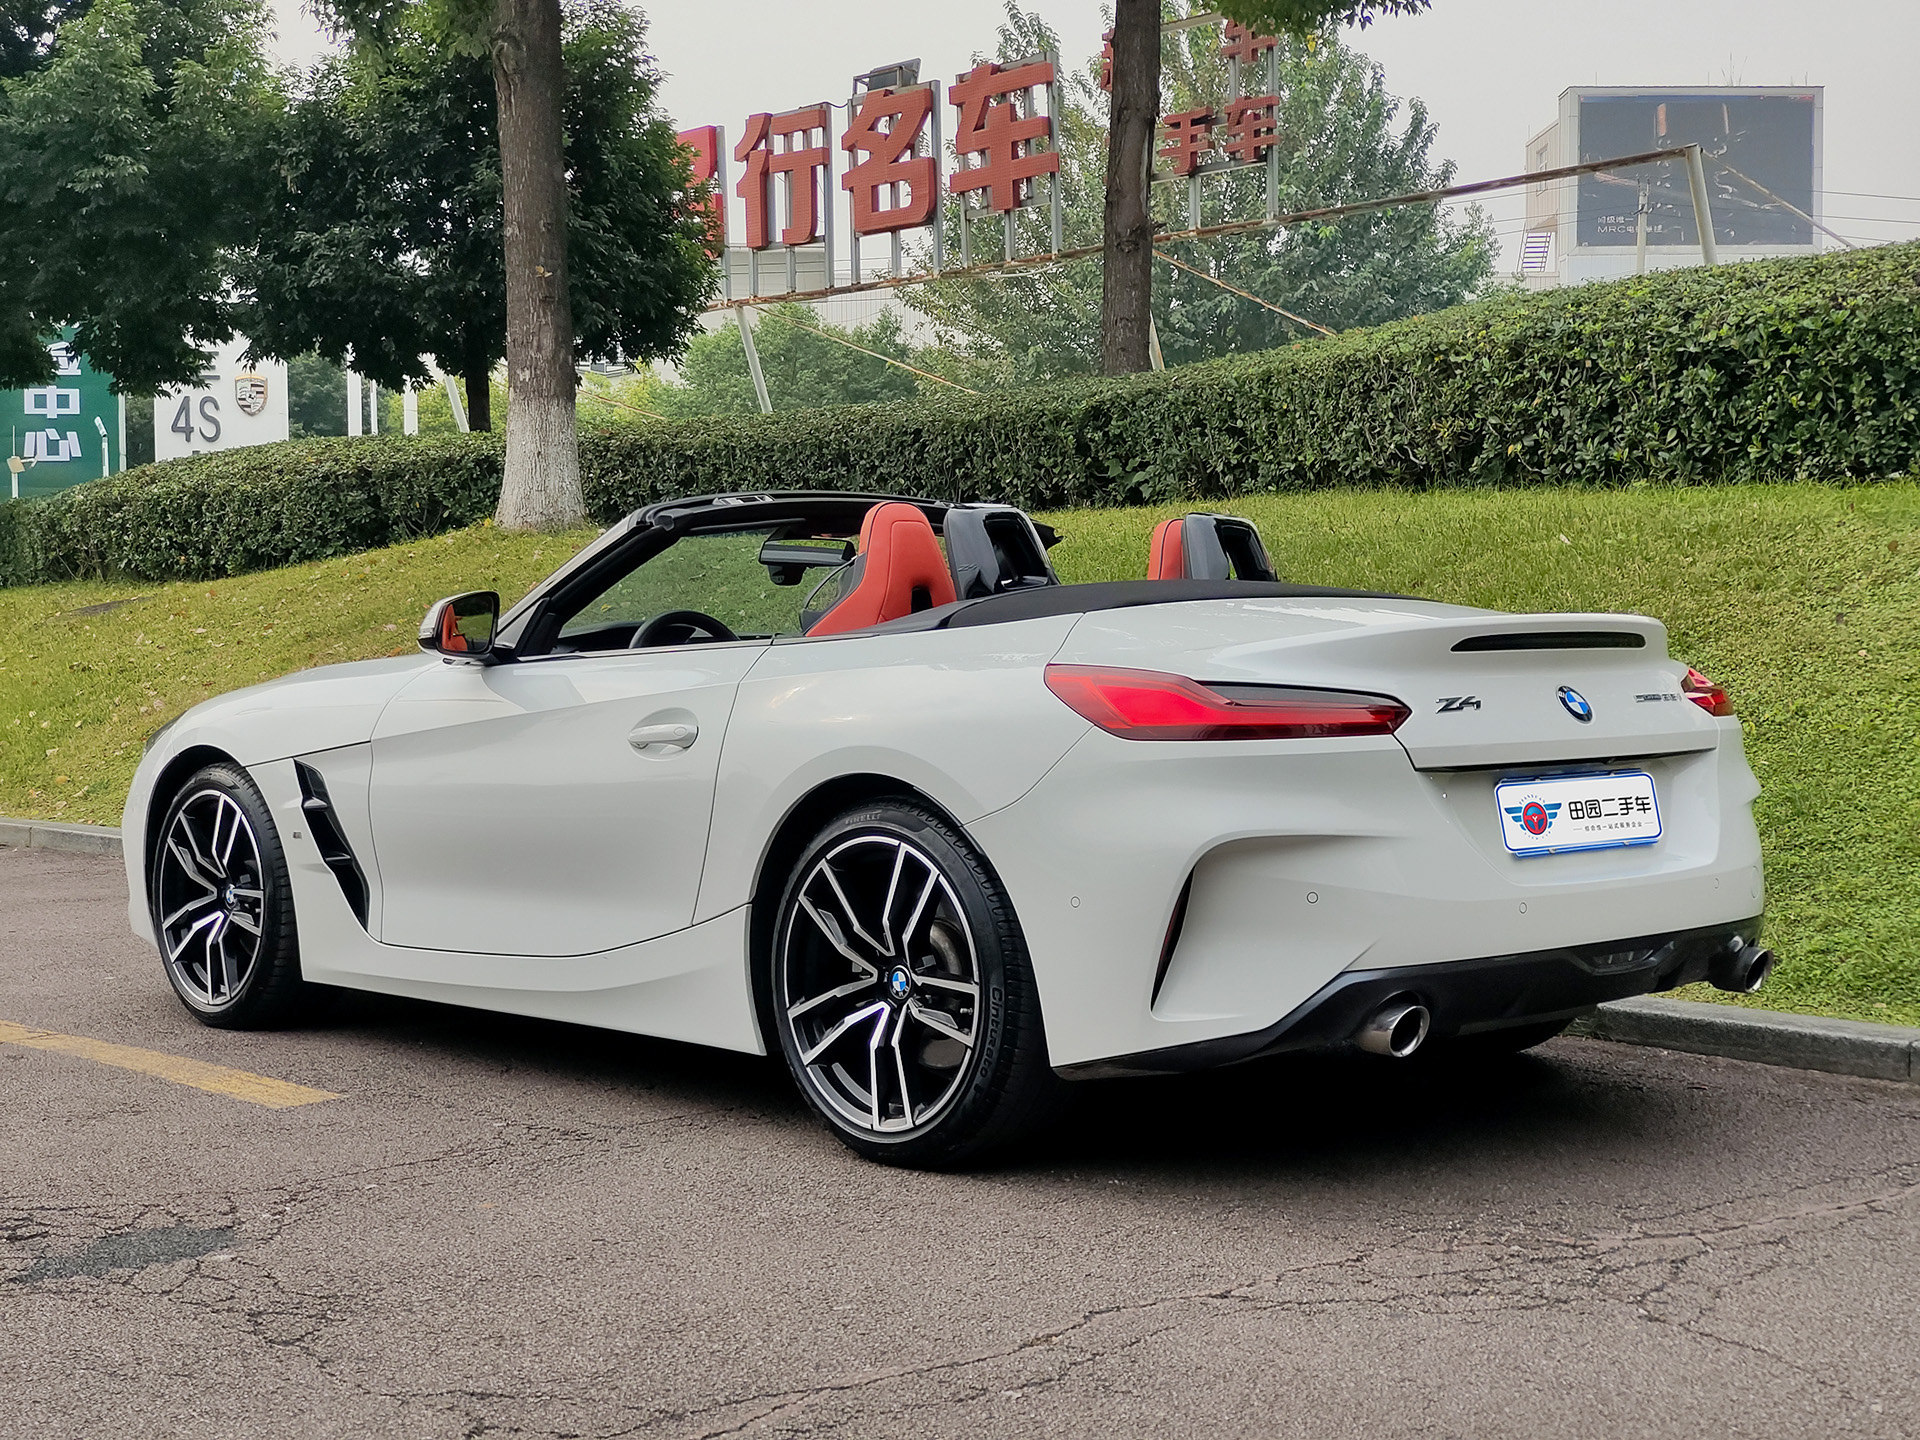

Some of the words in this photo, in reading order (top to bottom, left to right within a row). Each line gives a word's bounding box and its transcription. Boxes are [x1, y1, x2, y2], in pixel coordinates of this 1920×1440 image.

[171, 395, 221, 443] 4S
[1435, 695, 1482, 714] Z4
[1568, 796, 1651, 820] 田园二手车
[980, 987, 1003, 1078] Cinturato
